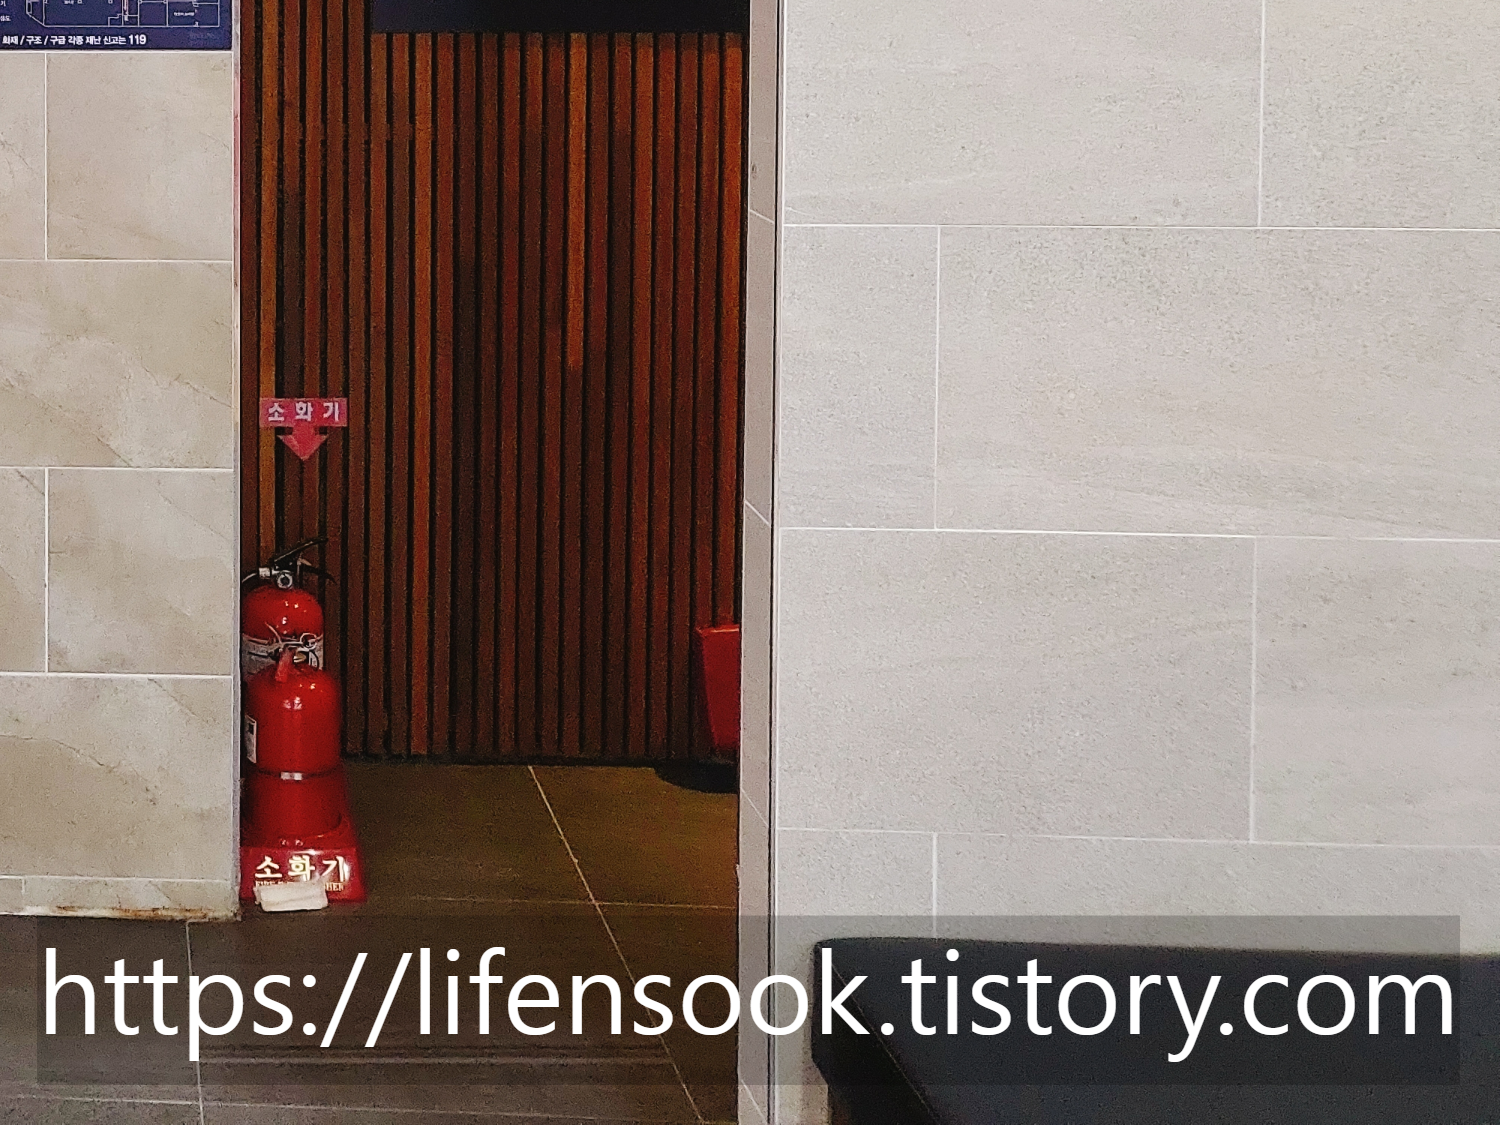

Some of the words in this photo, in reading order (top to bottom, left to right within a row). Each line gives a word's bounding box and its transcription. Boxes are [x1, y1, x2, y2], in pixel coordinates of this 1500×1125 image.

[2, 35, 19, 45] 화재
[26, 35, 43, 45] 구조
[50, 35, 66, 45] 구급
[67, 35, 84, 45] 각종
[85, 35, 102, 45] 재난
[103, 35, 127, 45] 신고는
[128, 34, 147, 45] 119
[268, 401, 340, 422] 소화기
[255, 855, 346, 882] 소화기
